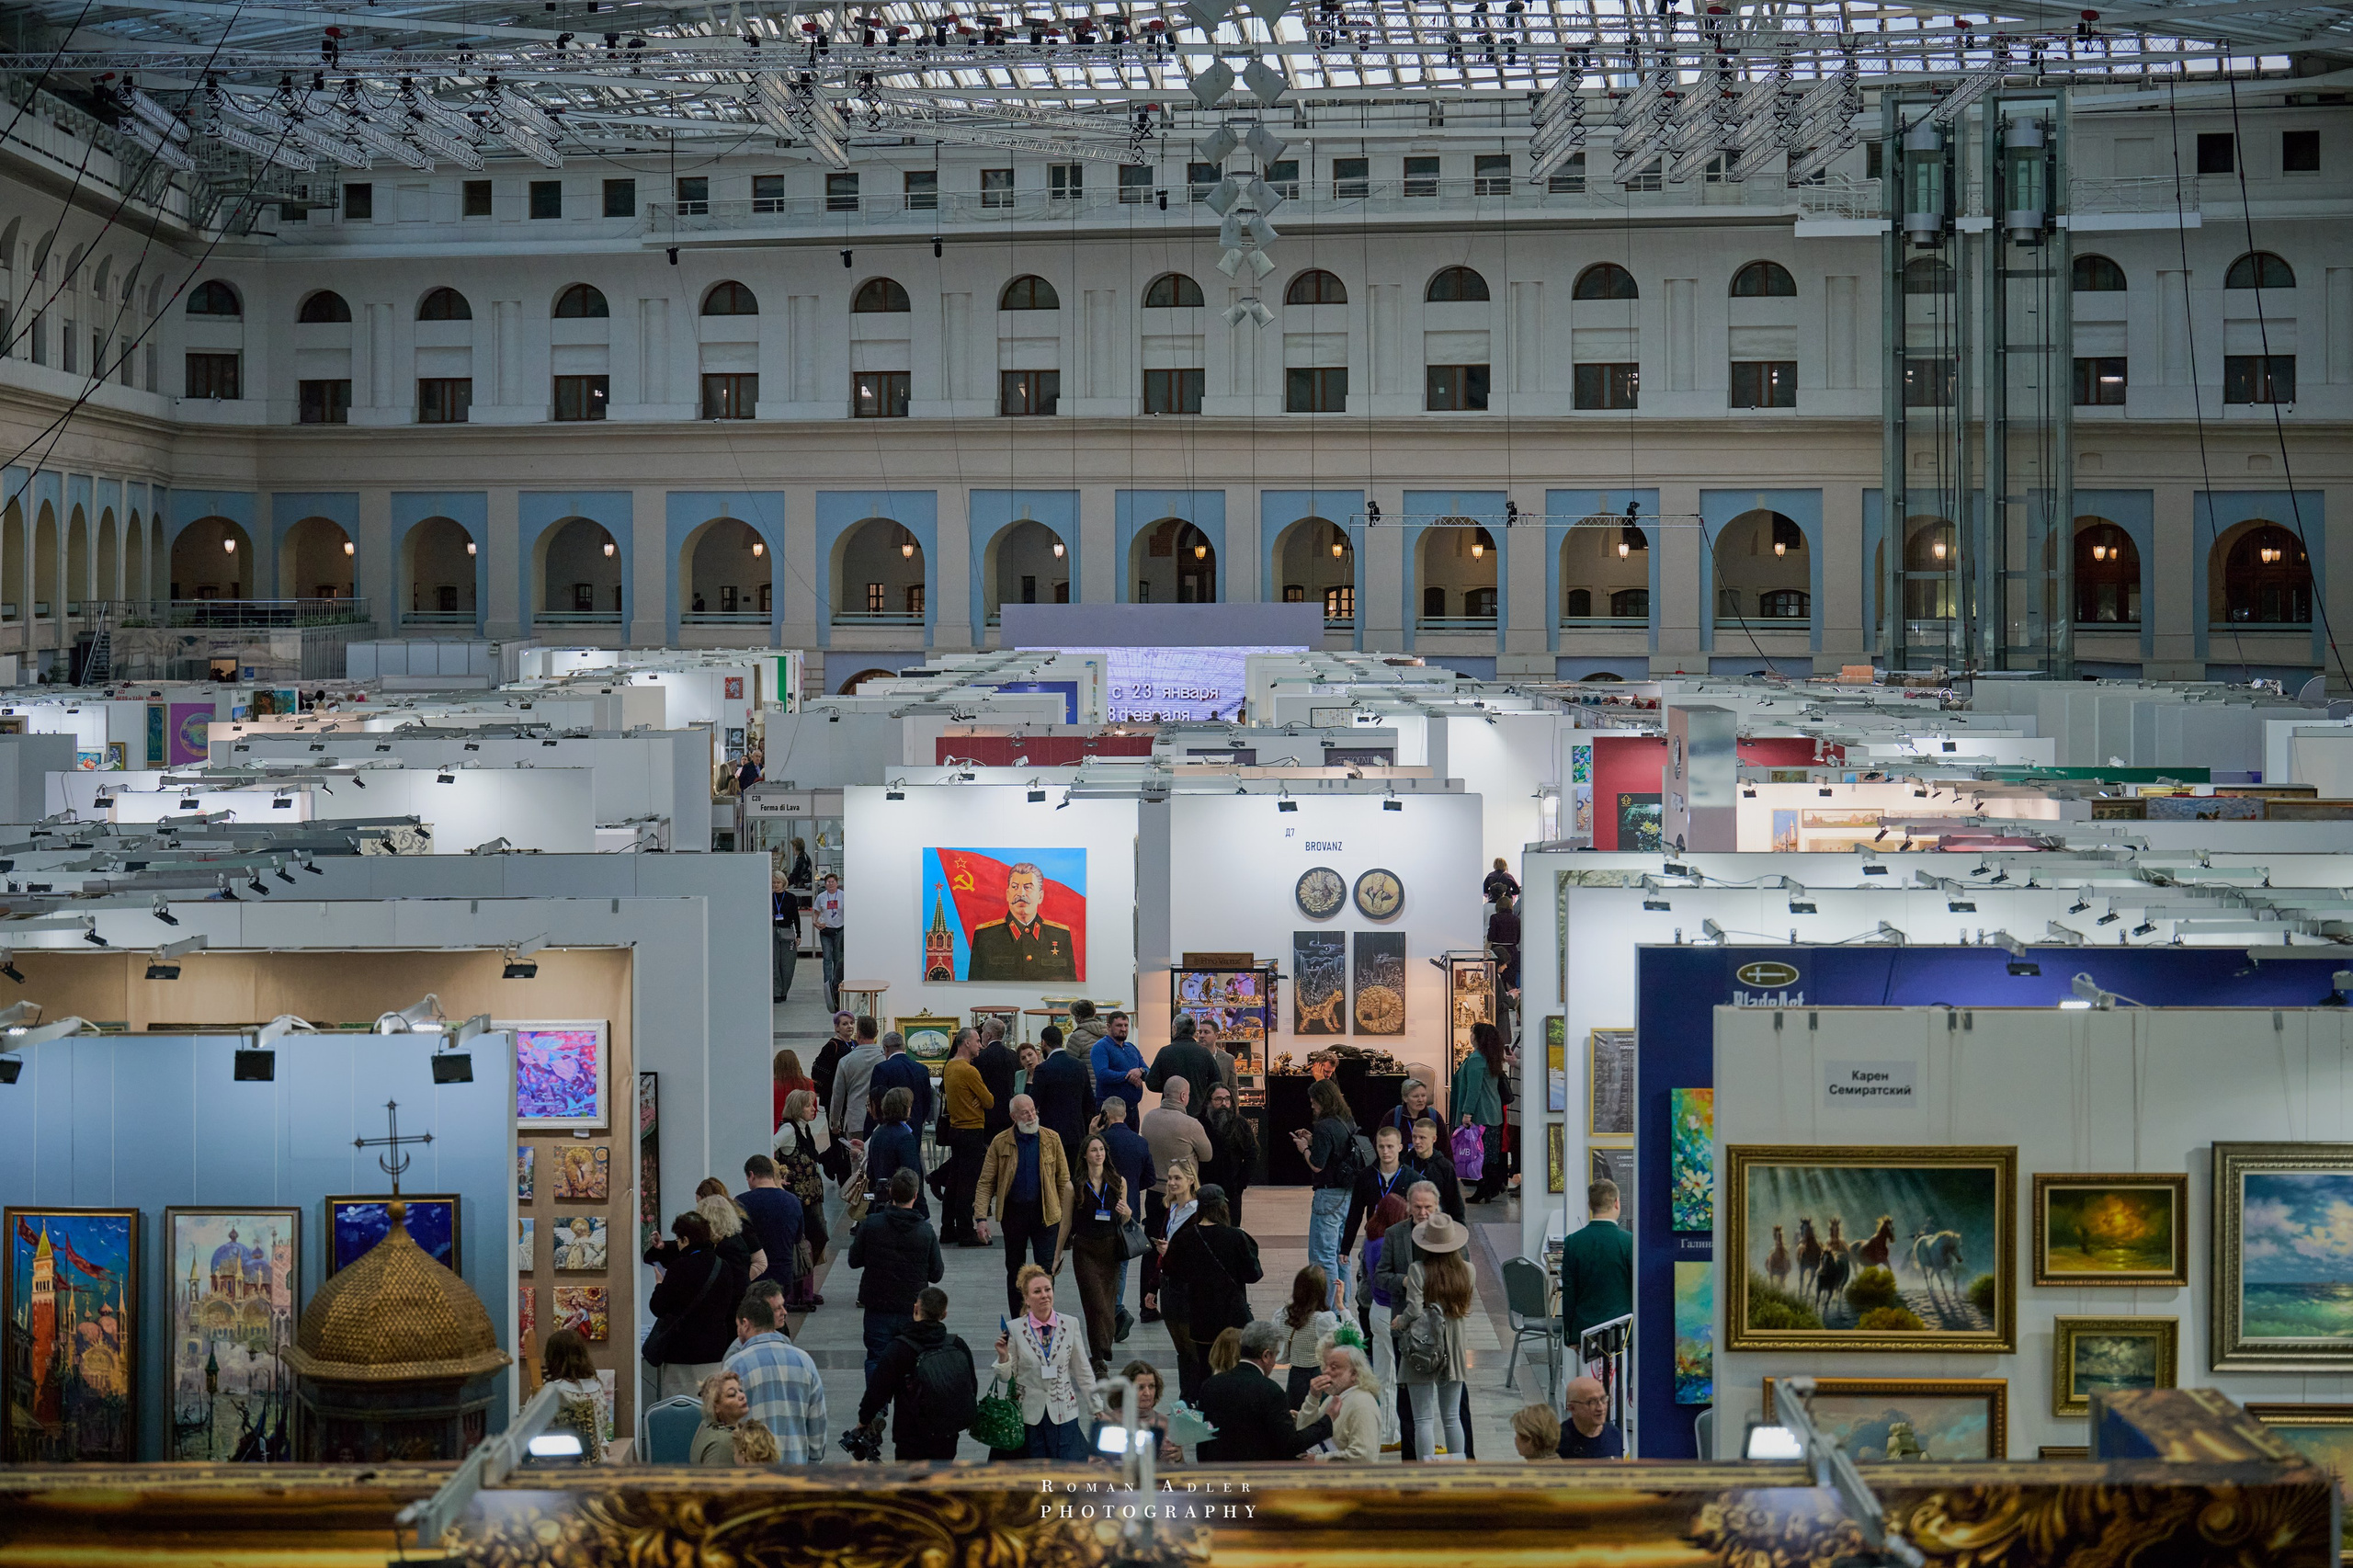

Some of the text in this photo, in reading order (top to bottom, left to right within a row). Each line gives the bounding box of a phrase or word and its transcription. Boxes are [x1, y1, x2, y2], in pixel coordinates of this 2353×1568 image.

[1112, 683, 1219, 701] с 23 января
[760, 803, 801, 812] Forma di Lava
[1285, 827, 1295, 838] Д7
[1305, 841, 1343, 851] BROVANZ
[1851, 1070, 1889, 1083] Карен
[1829, 1084, 1911, 1097] Семиратский
[1459, 1147, 1471, 1156] WB
